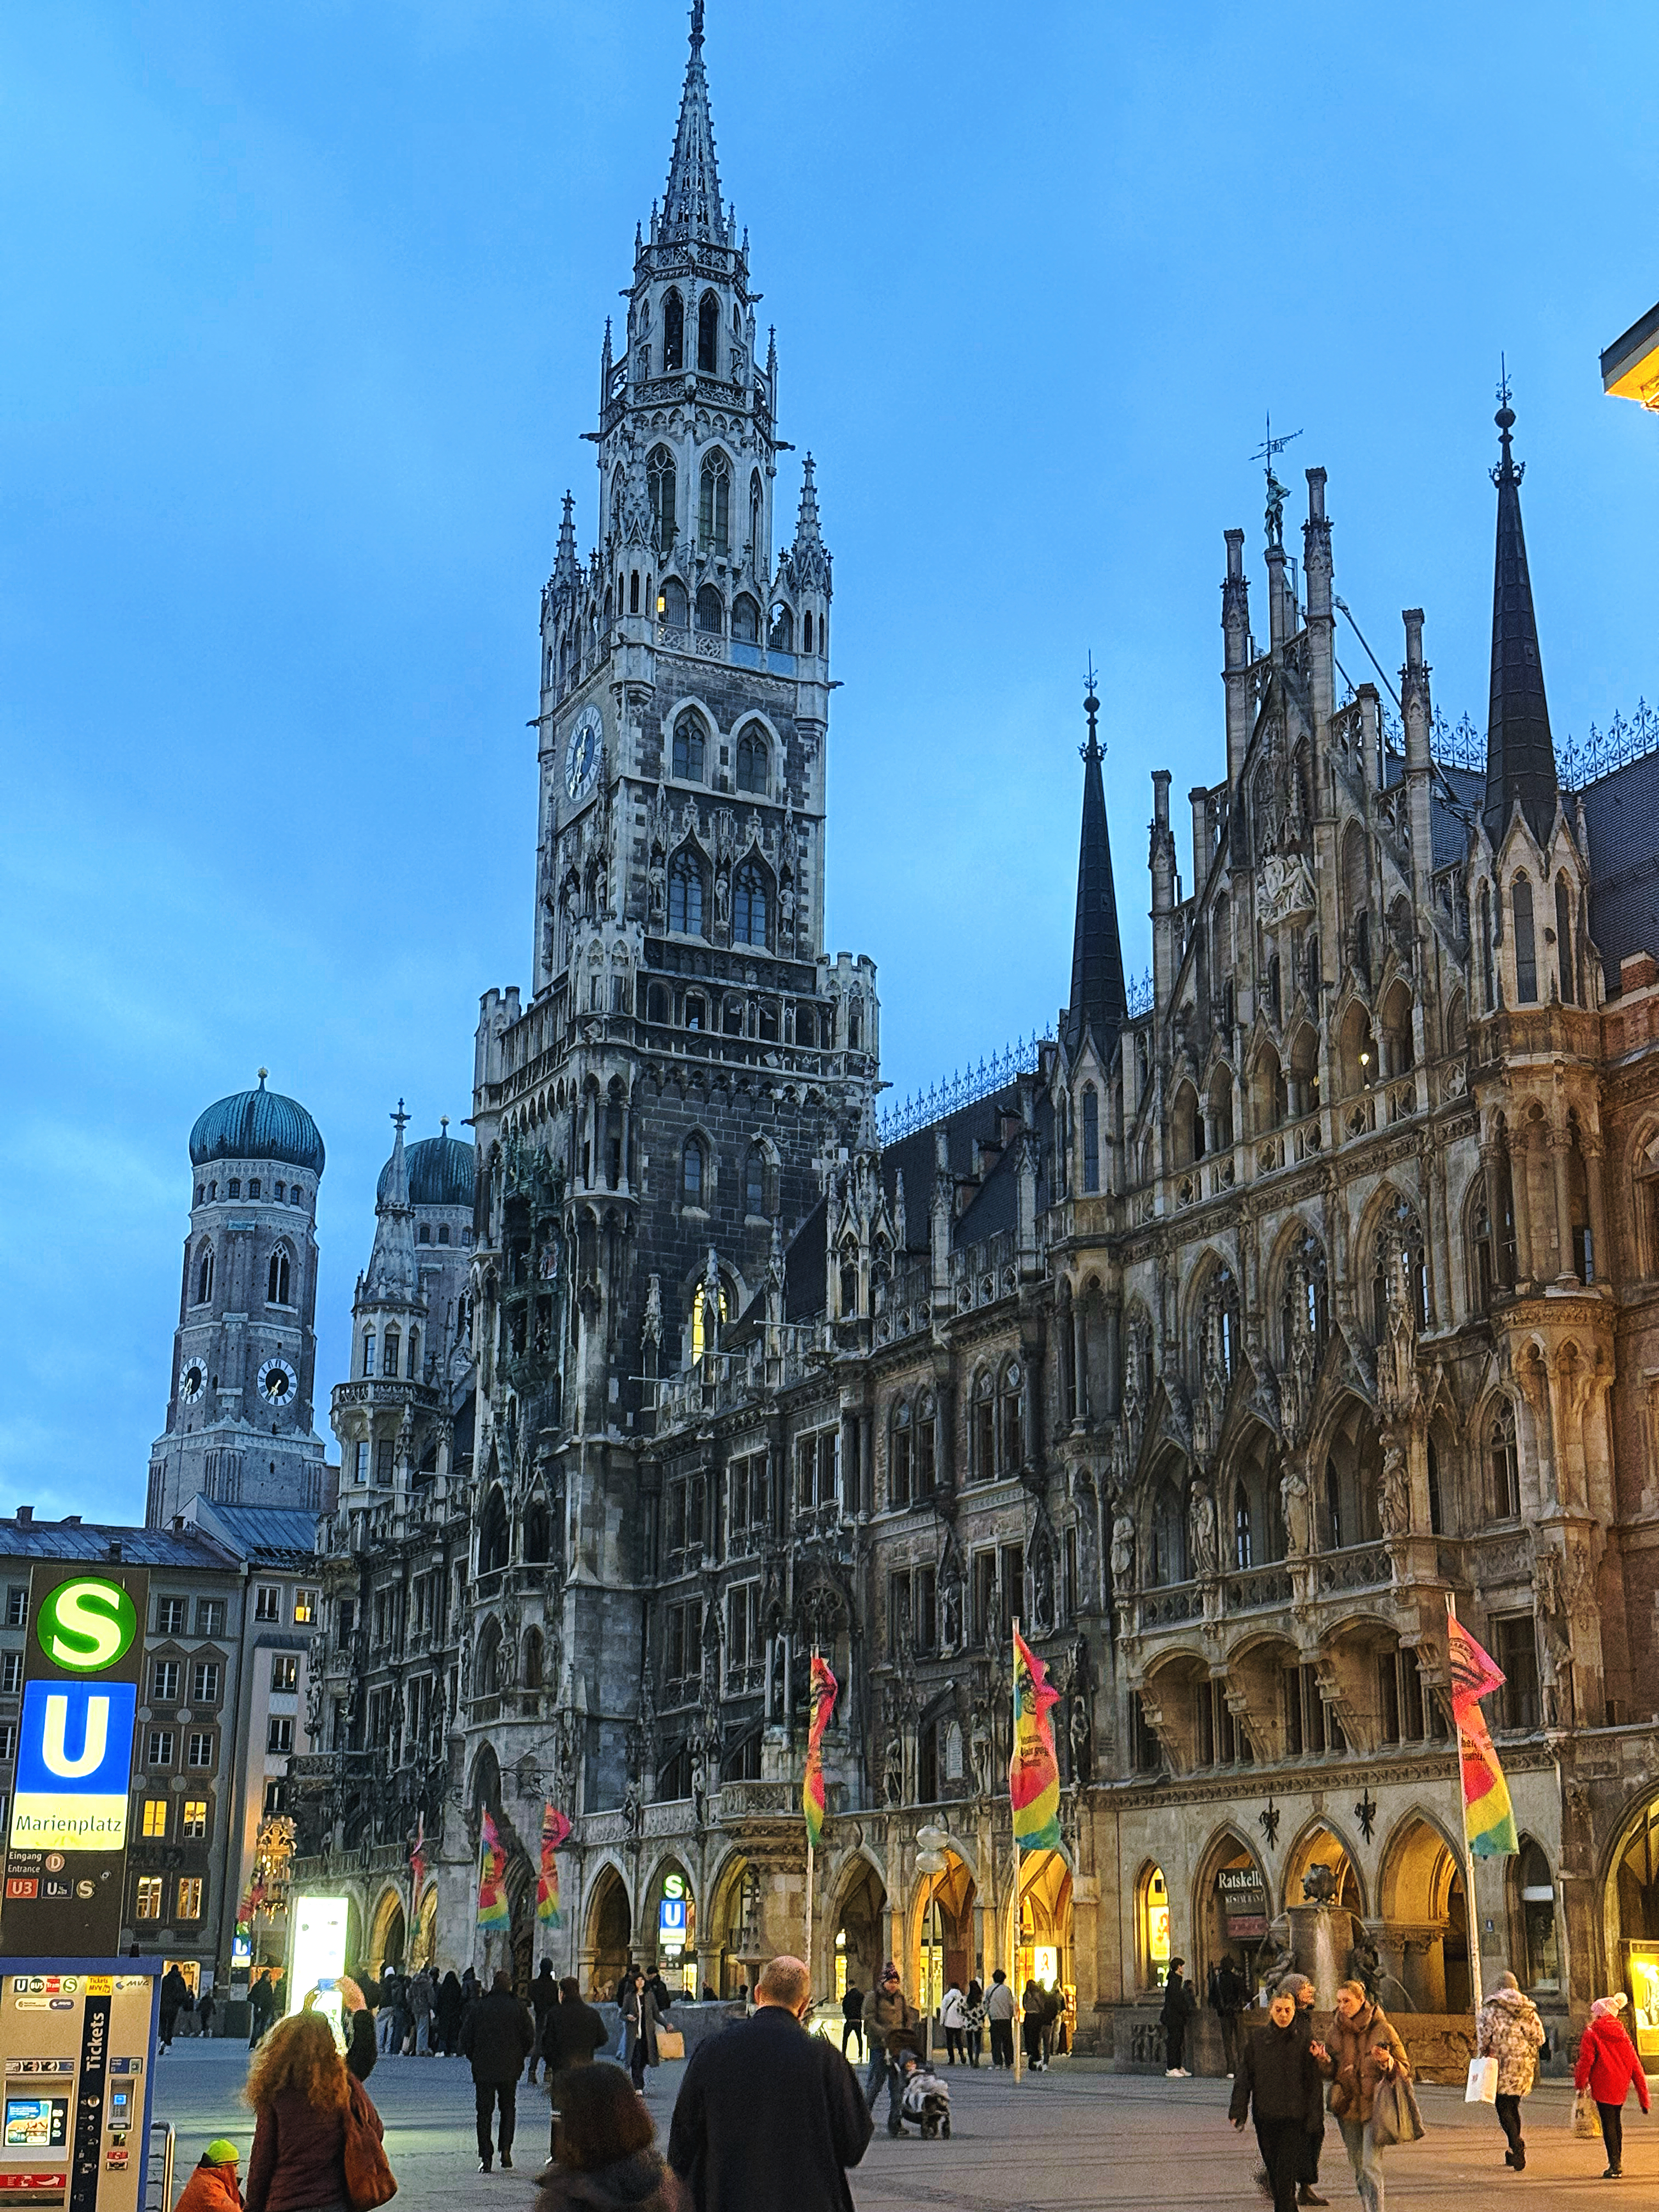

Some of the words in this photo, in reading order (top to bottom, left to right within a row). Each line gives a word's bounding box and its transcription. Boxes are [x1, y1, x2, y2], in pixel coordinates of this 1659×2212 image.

[53, 1583, 121, 1666] S
[42, 1695, 110, 1778] U
[15, 1814, 122, 1835] Marienplatz
[7, 1864, 41, 1873] Entrance
[8, 1851, 42, 1863] Eingang
[51, 1856, 61, 1869] D
[12, 1881, 32, 1895] U3
[80, 1880, 93, 1897] S
[665, 1875, 683, 1899] S
[665, 1904, 681, 1926] U
[16, 1980, 26, 1991] U
[65, 1979, 76, 1991] S
[86, 2012, 104, 2072] Tickets
